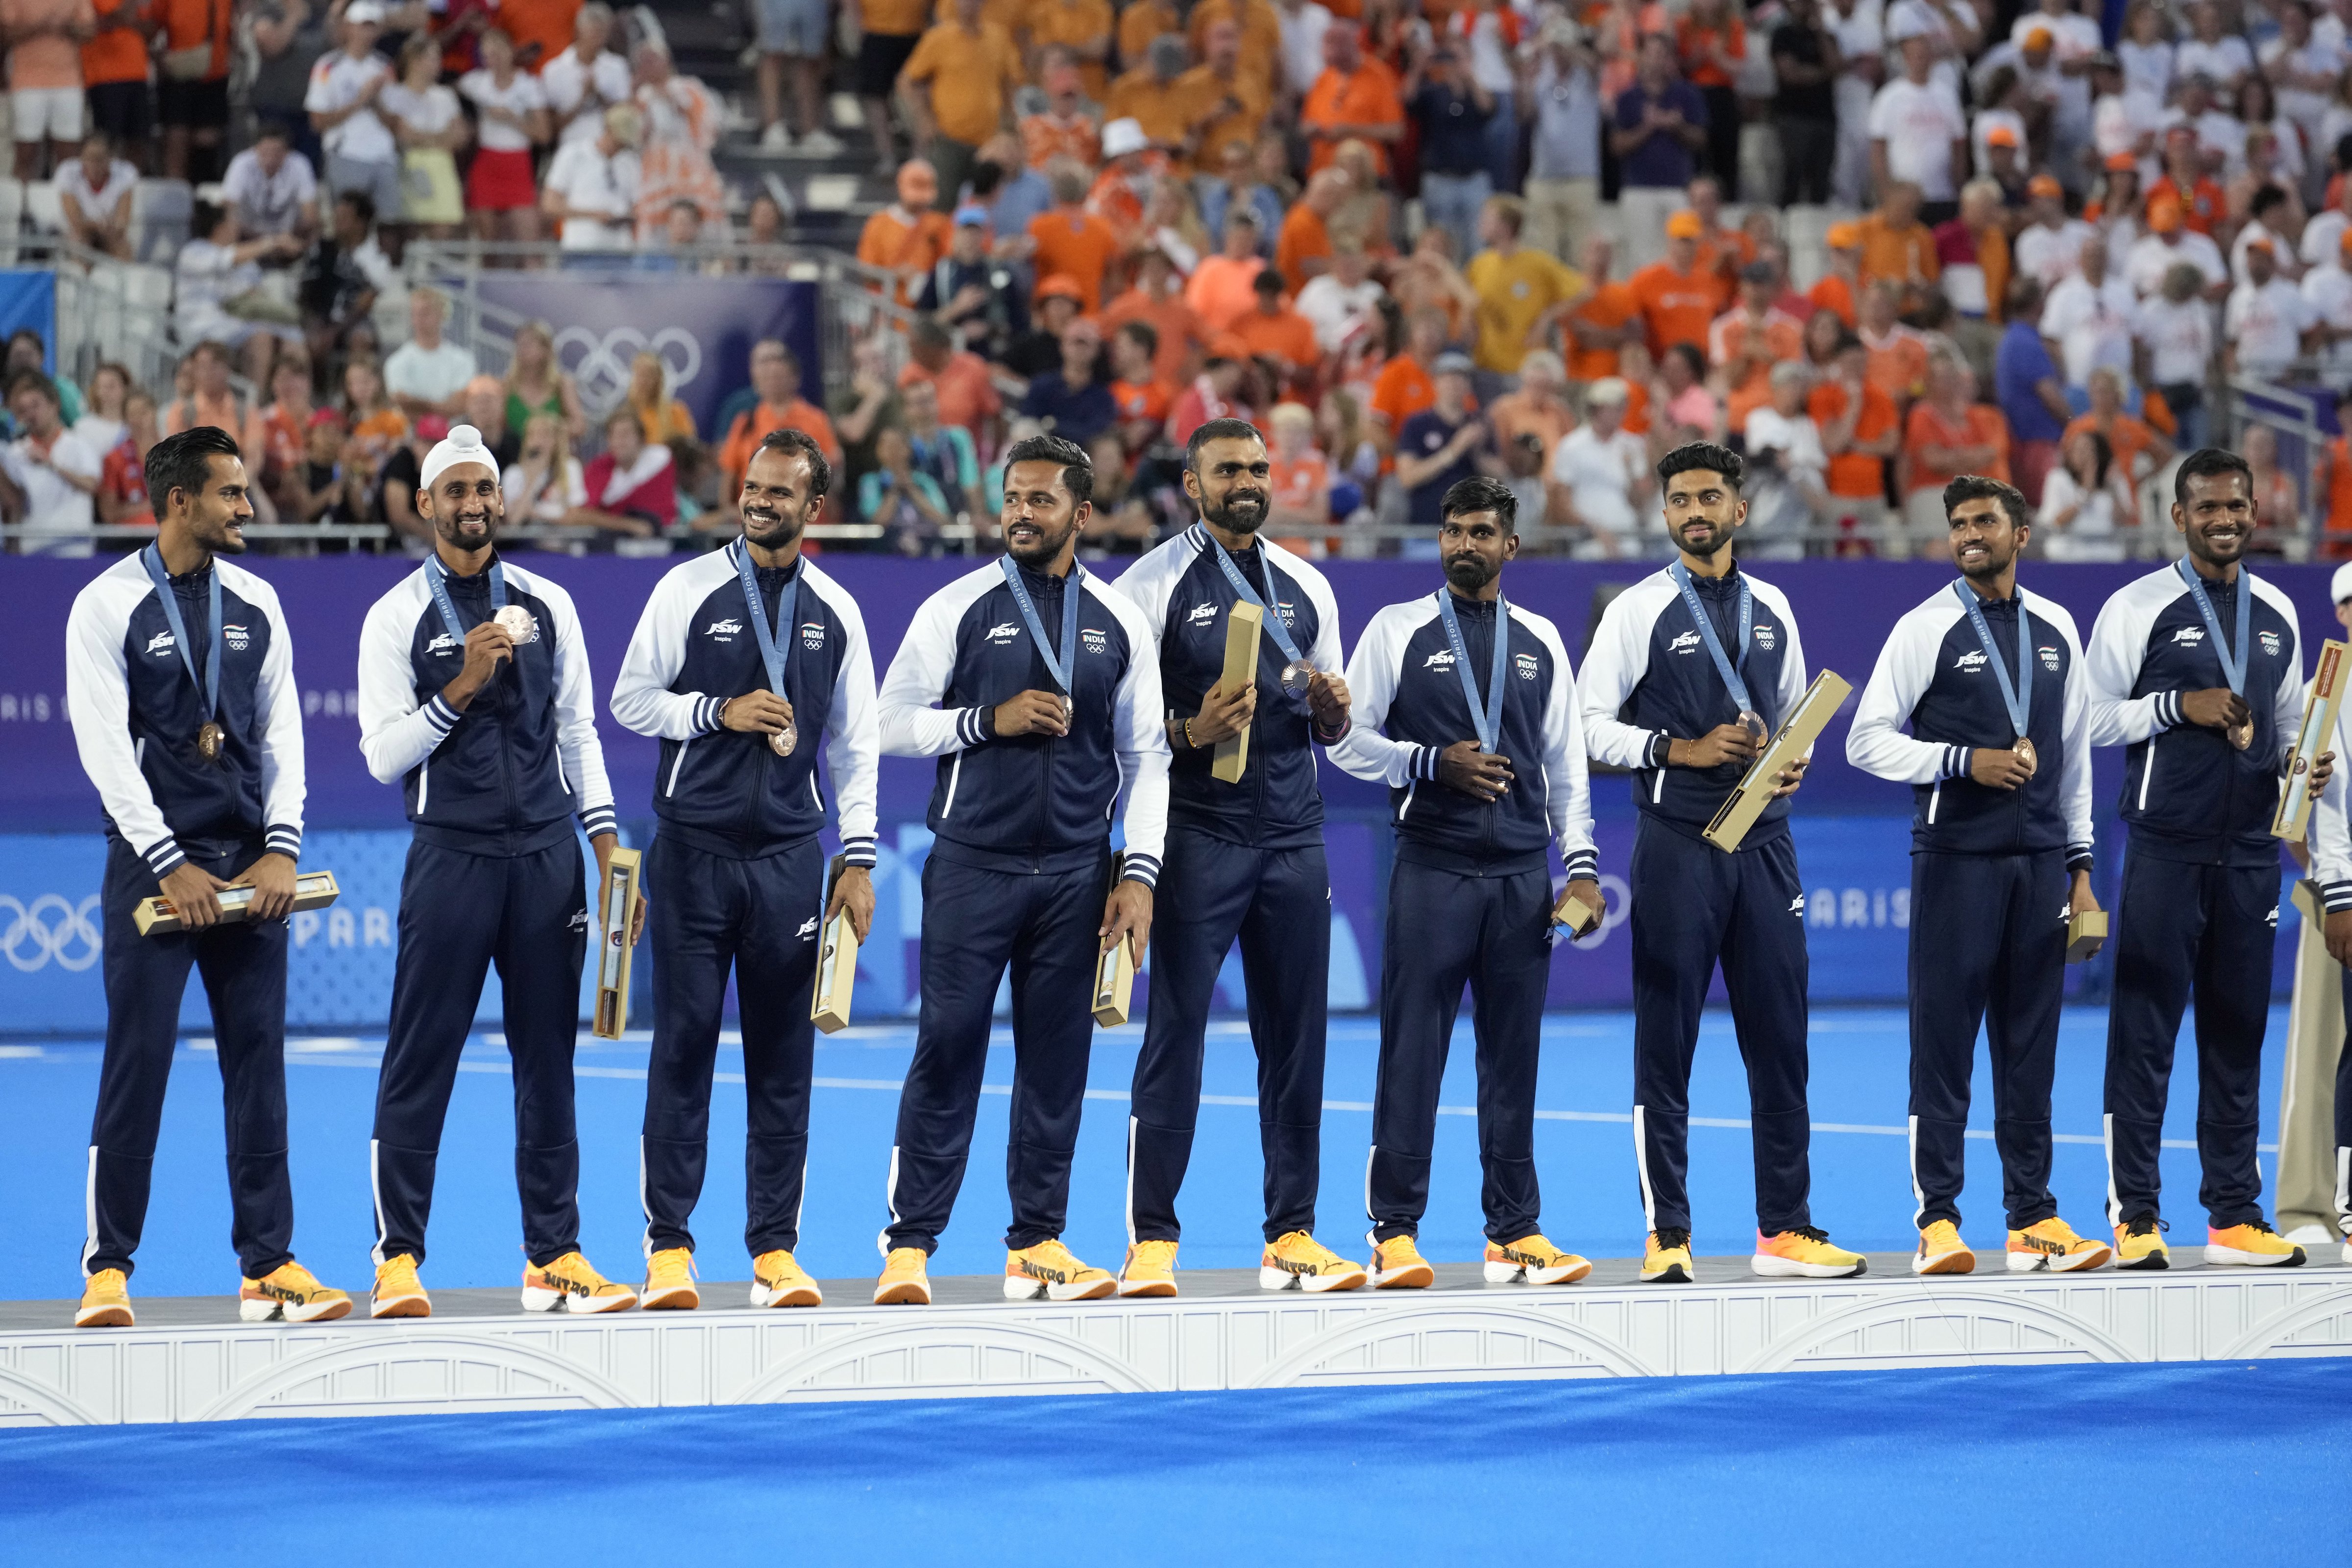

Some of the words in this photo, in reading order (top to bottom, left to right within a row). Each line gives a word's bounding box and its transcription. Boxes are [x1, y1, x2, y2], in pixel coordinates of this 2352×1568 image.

[744, 572, 753, 591] 2024
[1009, 574, 1021, 591] 2024
[1226, 567, 1241, 585] PARIS
[432, 579, 442, 597] 2024
[1684, 586, 1695, 604] 2024
[439, 598, 452, 618] PARIS
[749, 593, 760, 615] PARIS
[1017, 593, 1029, 612] PARIS
[1186, 605, 1219, 622] JSW
[1693, 605, 1705, 625] PARIS
[1970, 607, 1981, 624] 2024
[704, 623, 743, 635] JSW
[802, 629, 824, 640] INDIA
[984, 627, 1020, 640] JSW
[1447, 620, 1457, 638] 2024
[1978, 626, 1990, 644] PARIS
[2170, 629, 2205, 643] JSW
[145, 635, 175, 653] JSW
[1082, 635, 1106, 644] INDIA
[1667, 634, 1701, 651] JSW
[1453, 639, 1464, 660] PARIS
[2040, 653, 2059, 661] INDIA
[1422, 653, 1455, 667] JSW
[1517, 659, 1538, 671] INDIA
[1953, 654, 1988, 668] JSW
[304, 689, 359, 719] PAR
[294, 907, 391, 948] PAR
[2020, 1232, 2066, 1257] NITRO
[1270, 1251, 1317, 1278] NITRO
[1500, 1245, 1545, 1270] NITRO
[1017, 1255, 1066, 1285] NITRO
[257, 1279, 304, 1307] NITRO
[543, 1270, 590, 1298] NITRO
